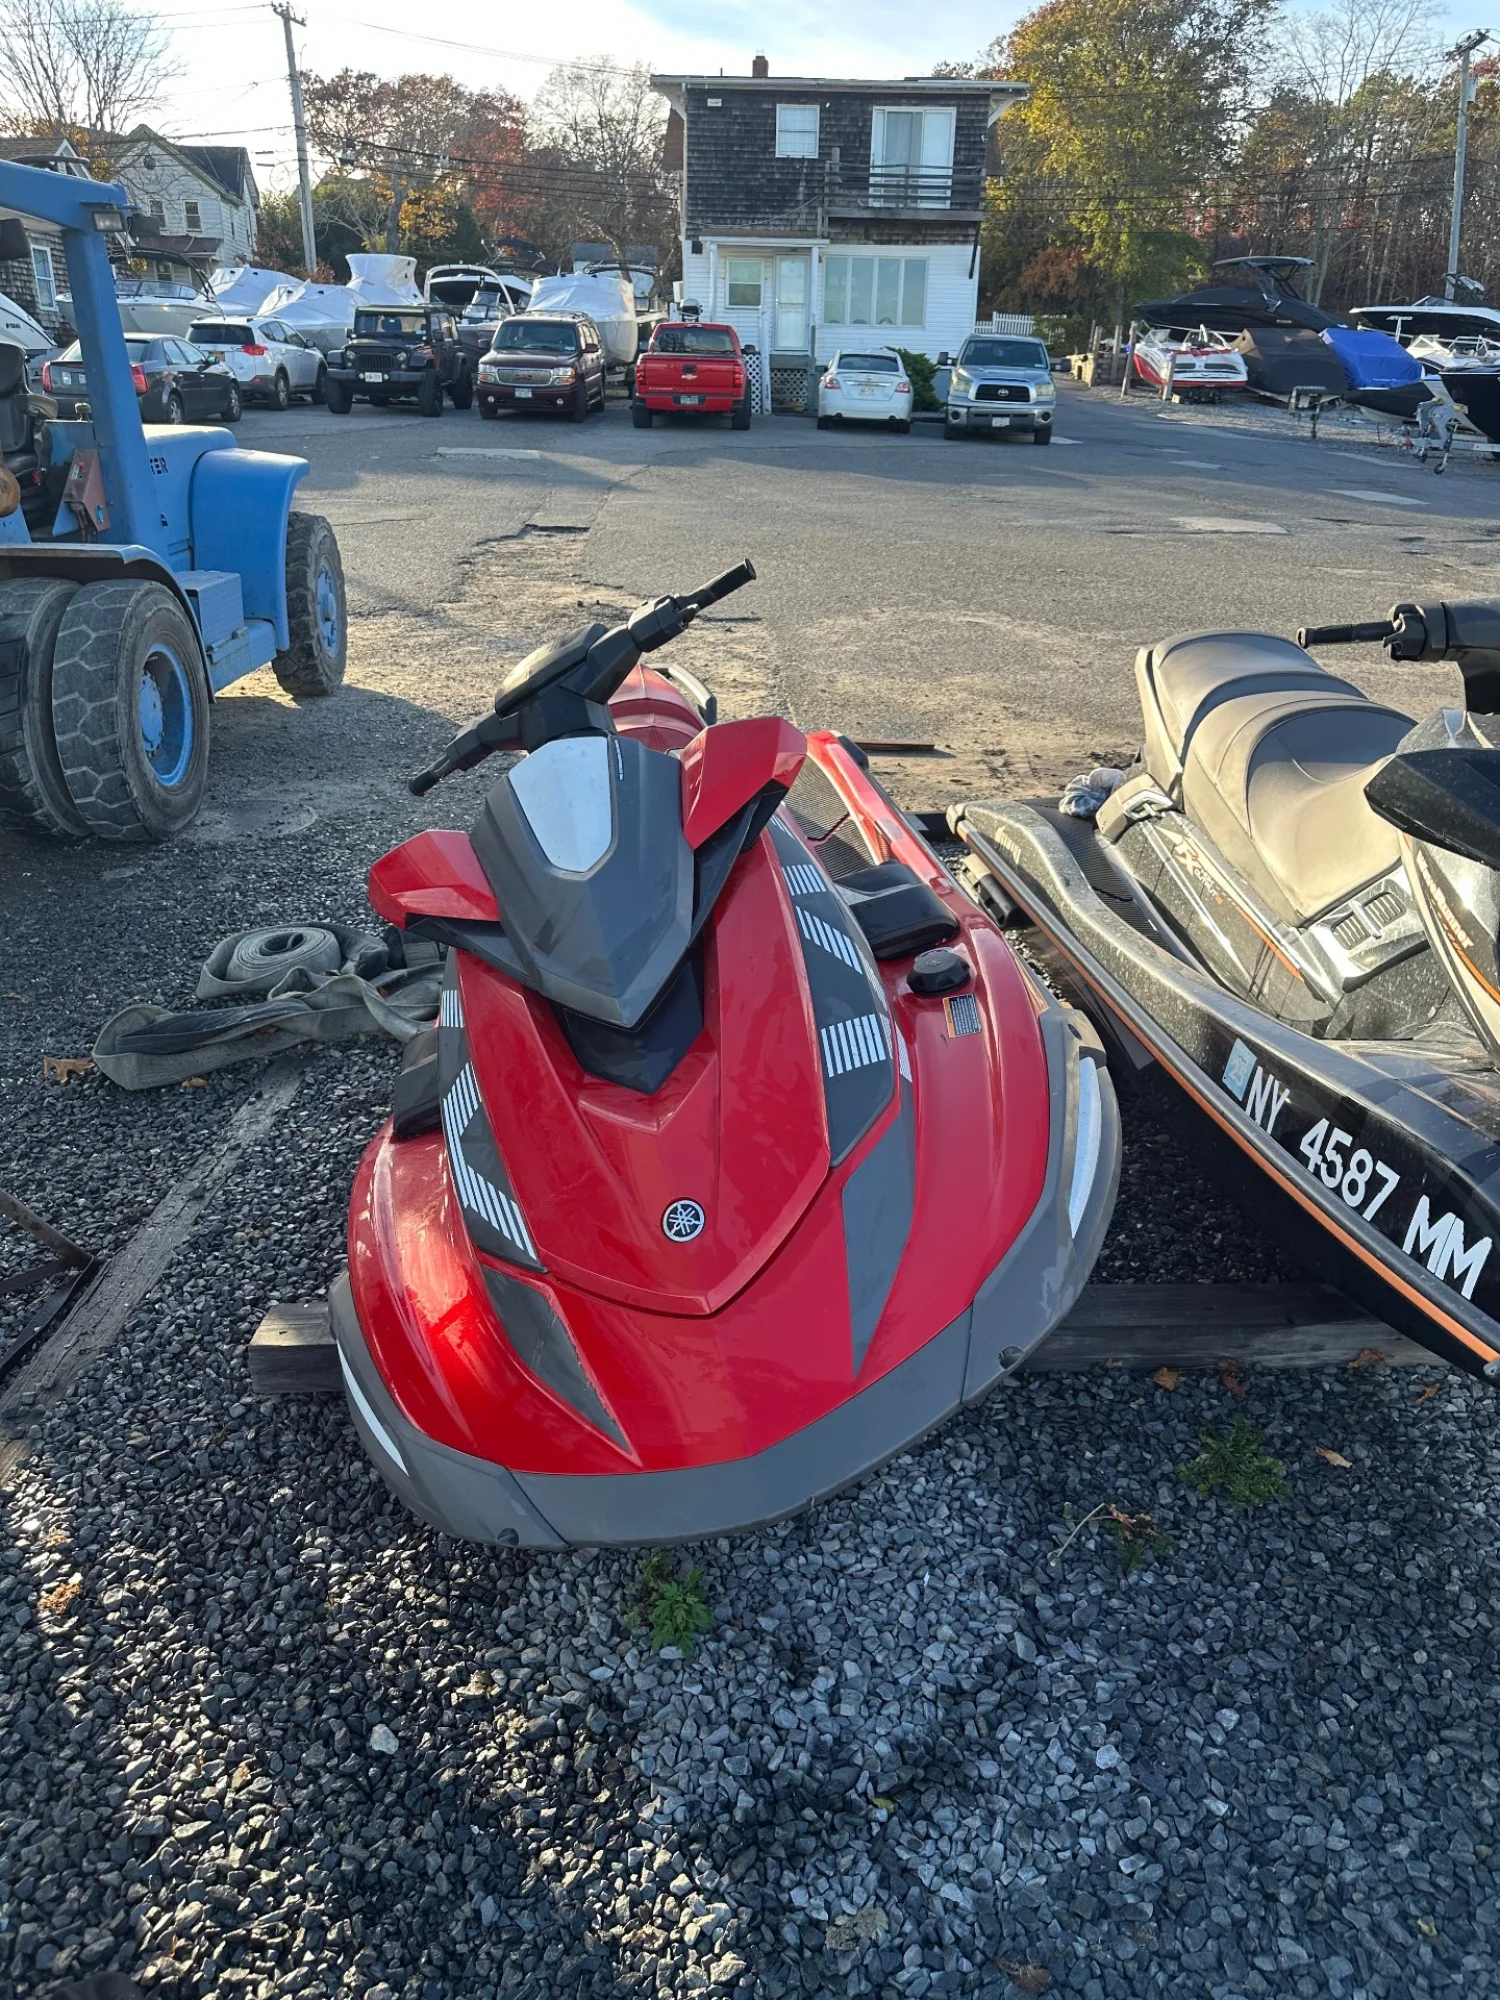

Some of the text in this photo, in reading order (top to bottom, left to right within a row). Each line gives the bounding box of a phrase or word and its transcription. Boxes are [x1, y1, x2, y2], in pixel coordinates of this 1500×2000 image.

[1194, 869, 1218, 897] OUTPUT
[1245, 1066, 1493, 1300] NY 4587 MM
